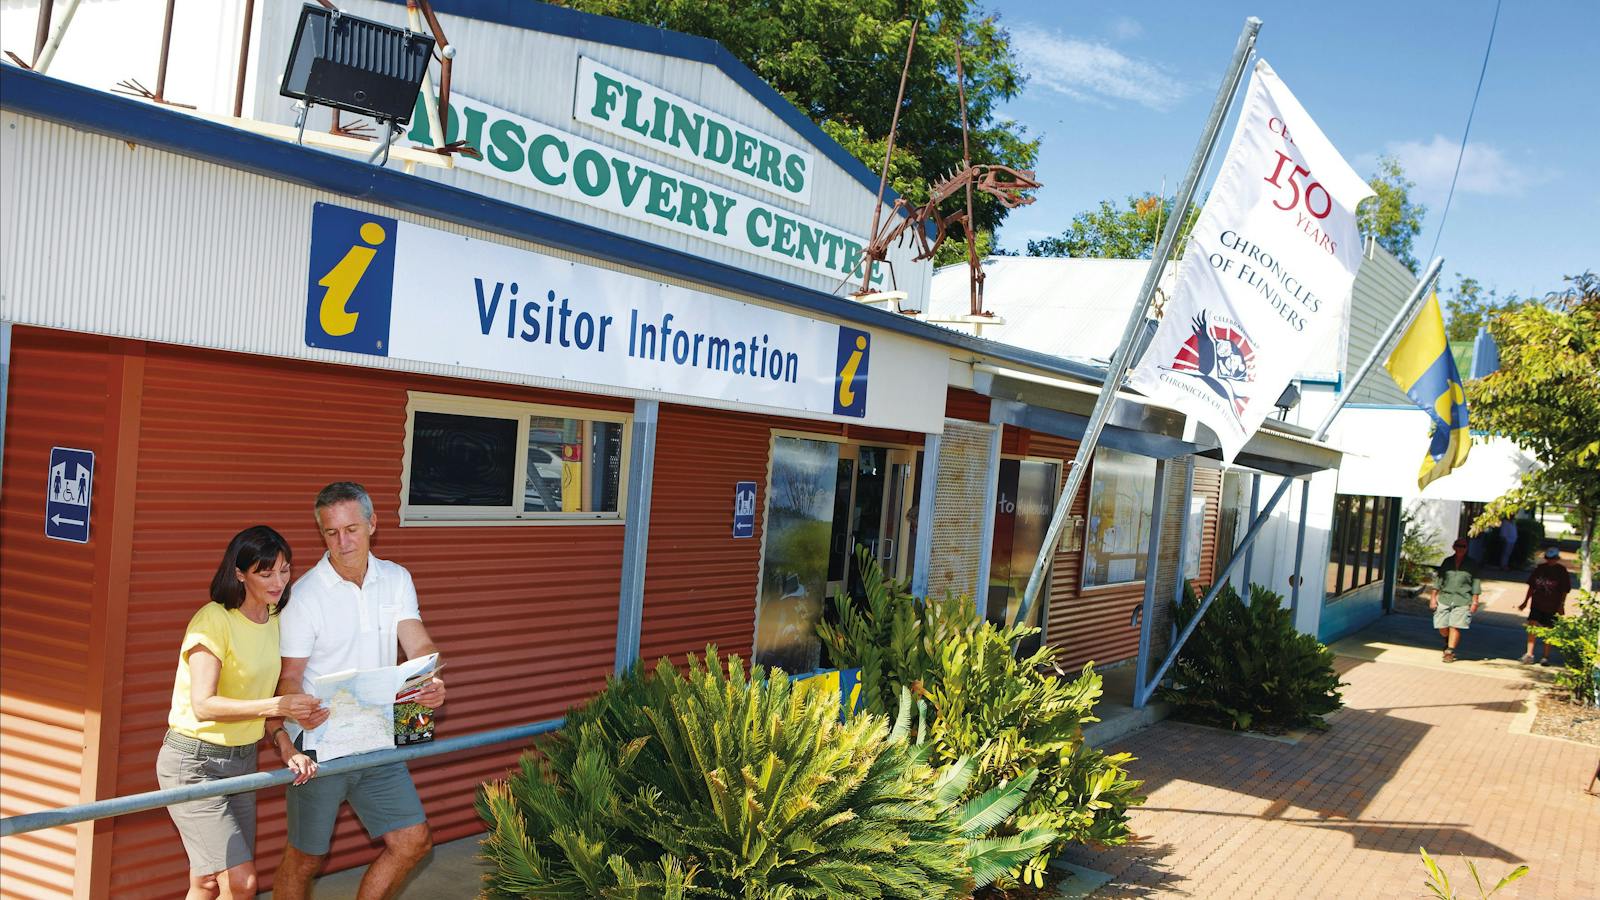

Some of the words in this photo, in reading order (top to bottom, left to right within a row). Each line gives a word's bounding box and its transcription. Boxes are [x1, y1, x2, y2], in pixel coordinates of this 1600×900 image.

[408, 92, 736, 236] DISCOVERY
[591, 72, 806, 193] FLINDERS
[1264, 150, 1332, 219] 150
[1220, 230, 1322, 313] CHRONICLES
[1296, 212, 1337, 255] YEARS
[474, 278, 612, 352] Visitor
[629, 309, 798, 383] Information
[1209, 253, 1235, 272] OF
[1238, 264, 1307, 332] FLINDERS
[1159, 373, 1211, 402] CHRONICLES
[998, 492, 1015, 513] to
